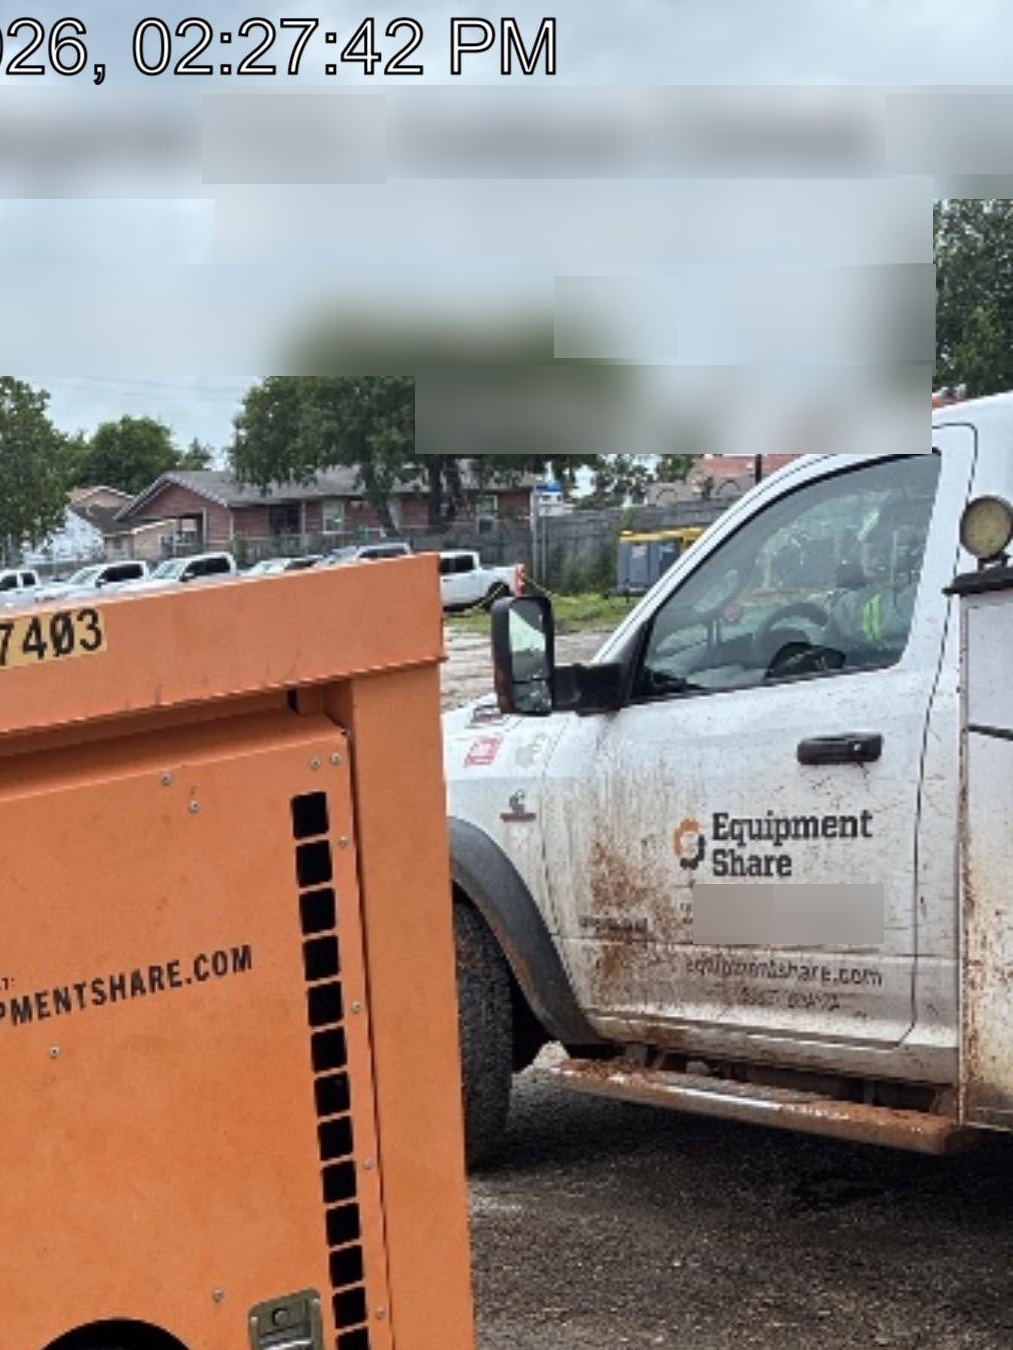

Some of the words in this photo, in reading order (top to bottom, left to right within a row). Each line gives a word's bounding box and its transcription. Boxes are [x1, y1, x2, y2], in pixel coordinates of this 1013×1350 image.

[712, 810, 874, 846] Equipment
[712, 849, 793, 877] Share
[684, 956, 883, 987] equipmentshare.com
